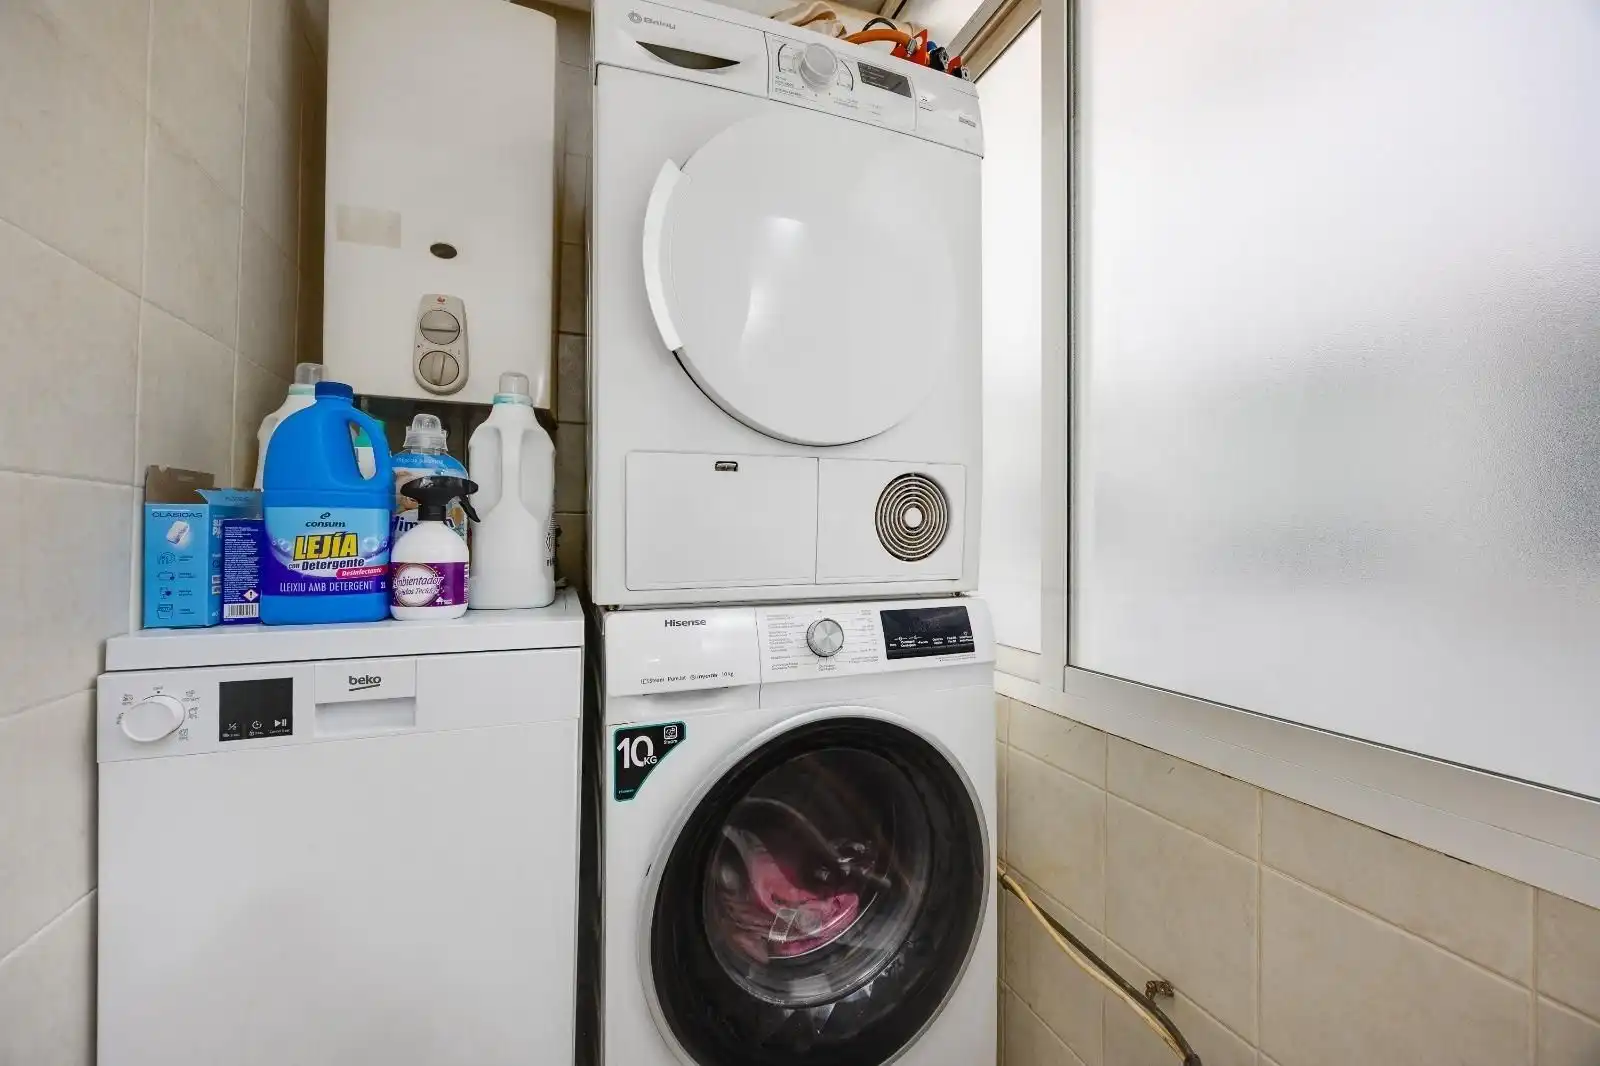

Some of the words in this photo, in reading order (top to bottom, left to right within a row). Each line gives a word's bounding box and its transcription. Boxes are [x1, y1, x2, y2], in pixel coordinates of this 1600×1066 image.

[293, 532, 359, 561] LEJÍA
[301, 558, 365, 571] Detergente
[279, 582, 306, 592] LLEIXIU
[308, 582, 327, 592] AMB
[329, 580, 374, 592] DETERGENT
[664, 619, 707, 628] Hisense
[348, 674, 382, 686] beko
[616, 735, 655, 769] 10
[643, 755, 659, 766] KG
